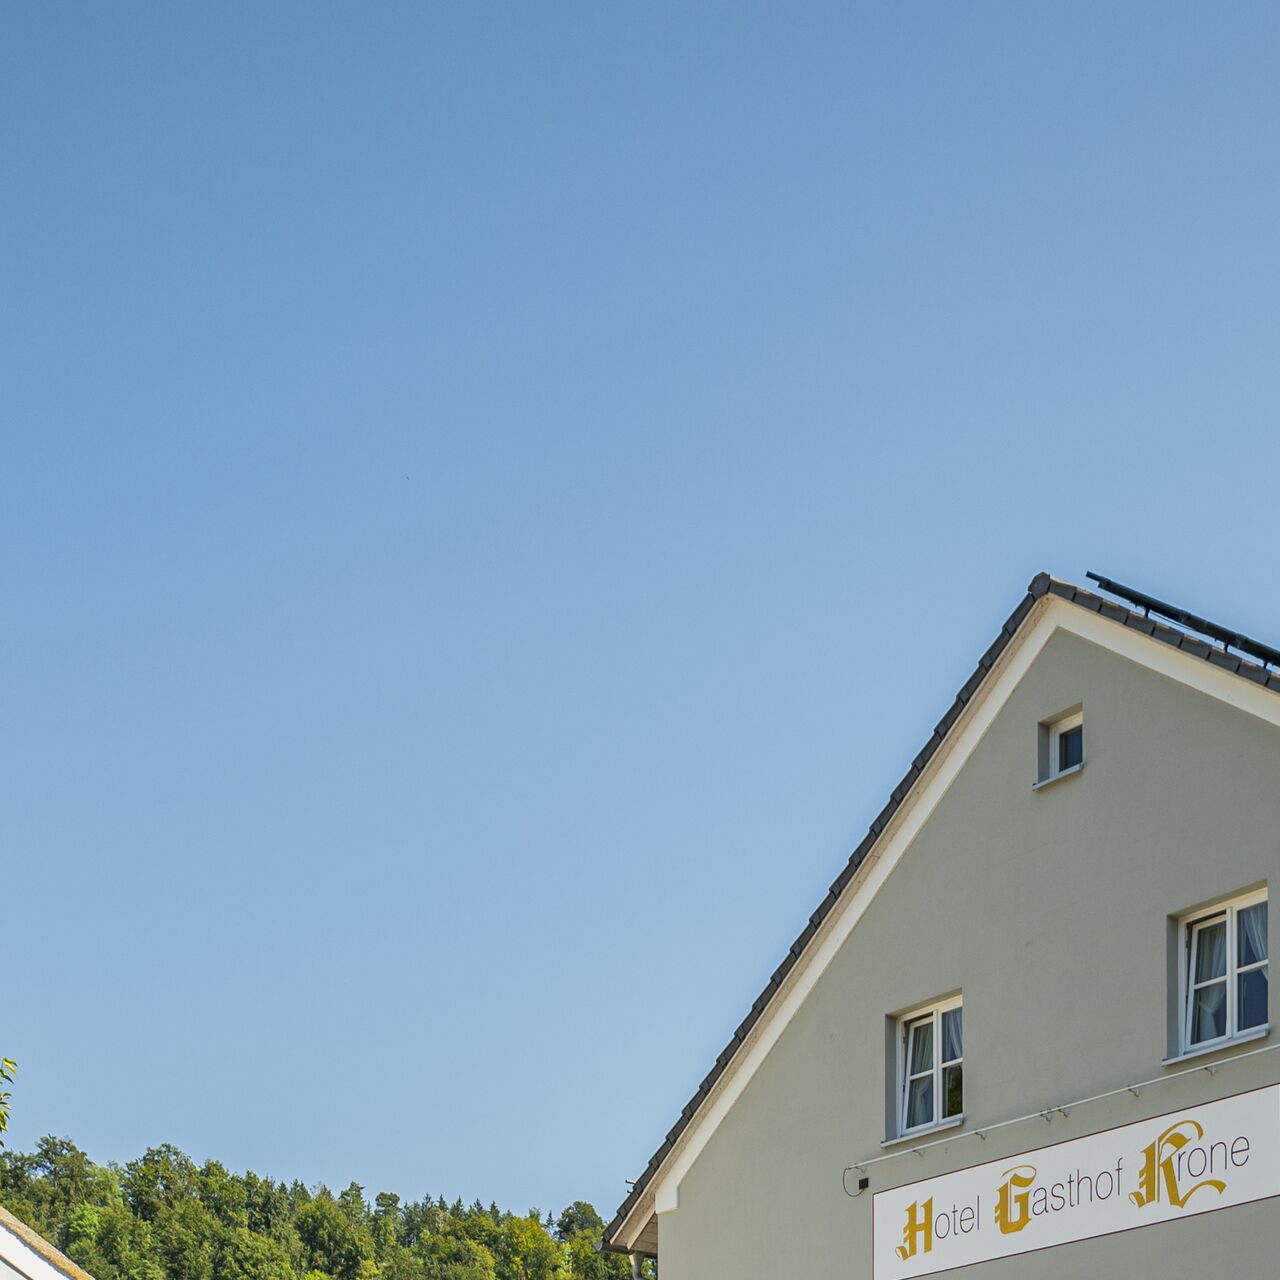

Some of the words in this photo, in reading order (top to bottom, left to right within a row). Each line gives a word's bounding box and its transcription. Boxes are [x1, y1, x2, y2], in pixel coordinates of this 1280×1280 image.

[895, 1195, 981, 1261] Hotel
[994, 1157, 1124, 1236] Gasthof
[1128, 1119, 1250, 1209] Krone
